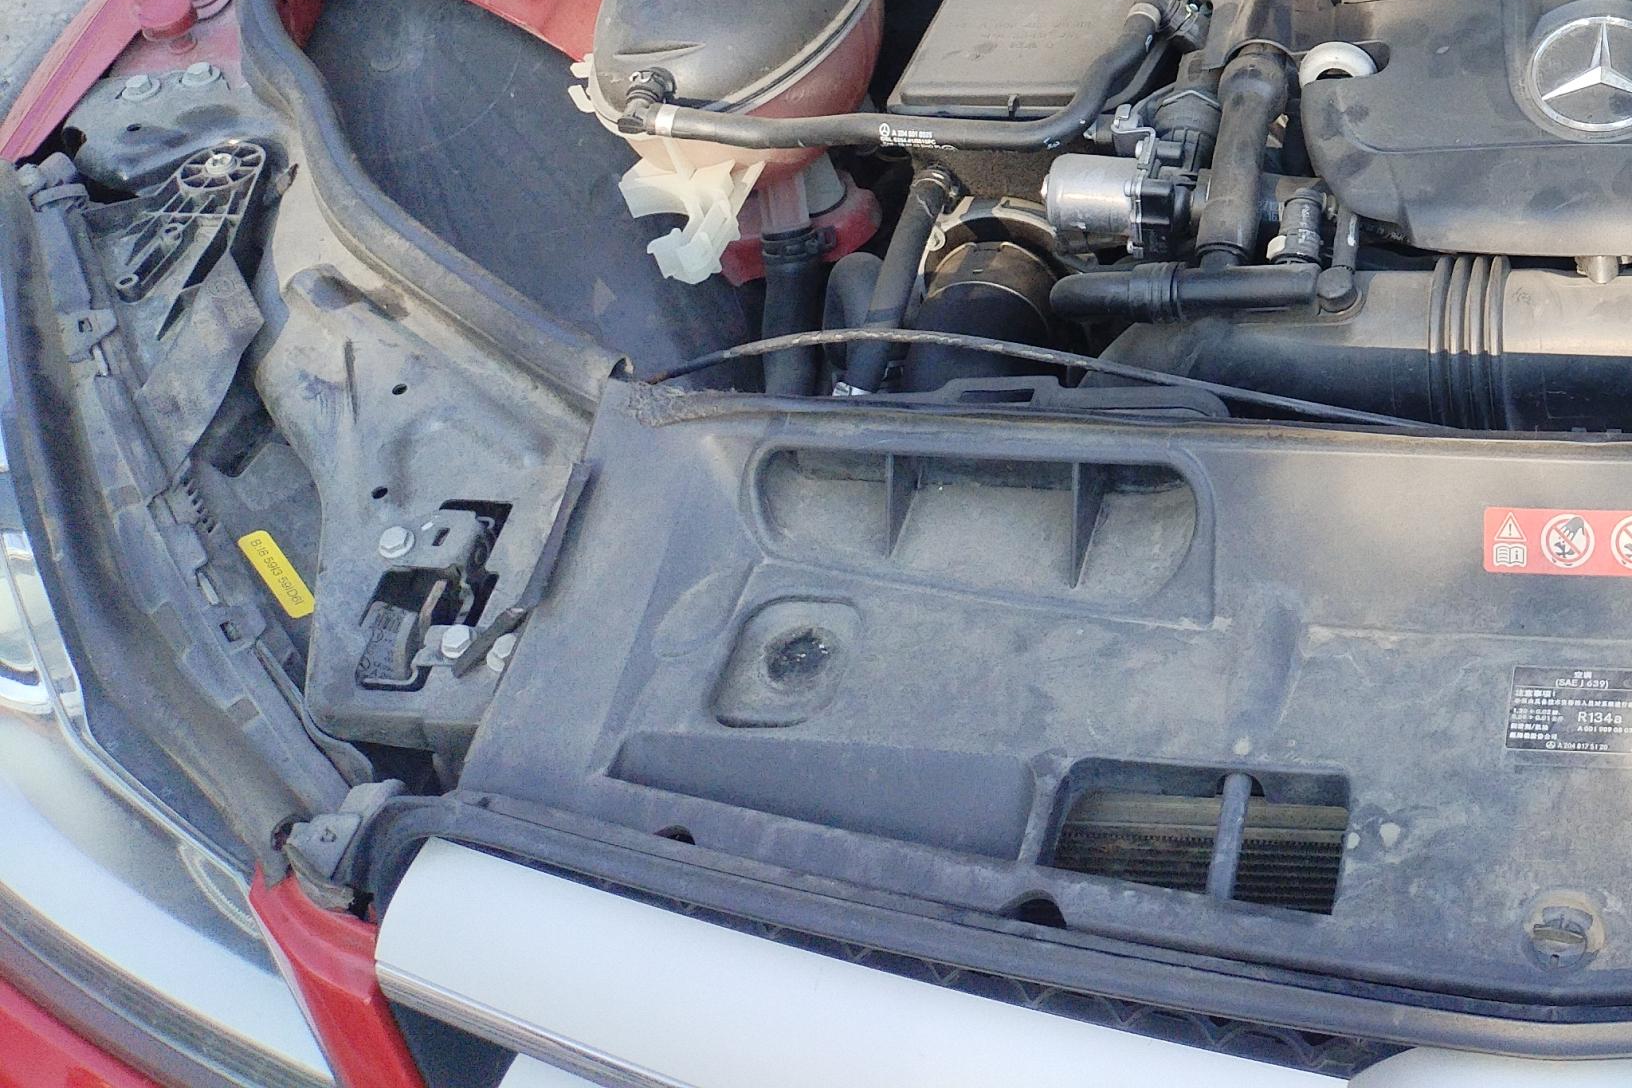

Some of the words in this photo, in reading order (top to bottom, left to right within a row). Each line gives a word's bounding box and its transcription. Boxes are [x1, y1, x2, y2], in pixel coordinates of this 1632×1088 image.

[1555, 679, 1578, 688] (SAE
[1579, 679, 1584, 687] J
[1577, 711, 1623, 724] R134a
